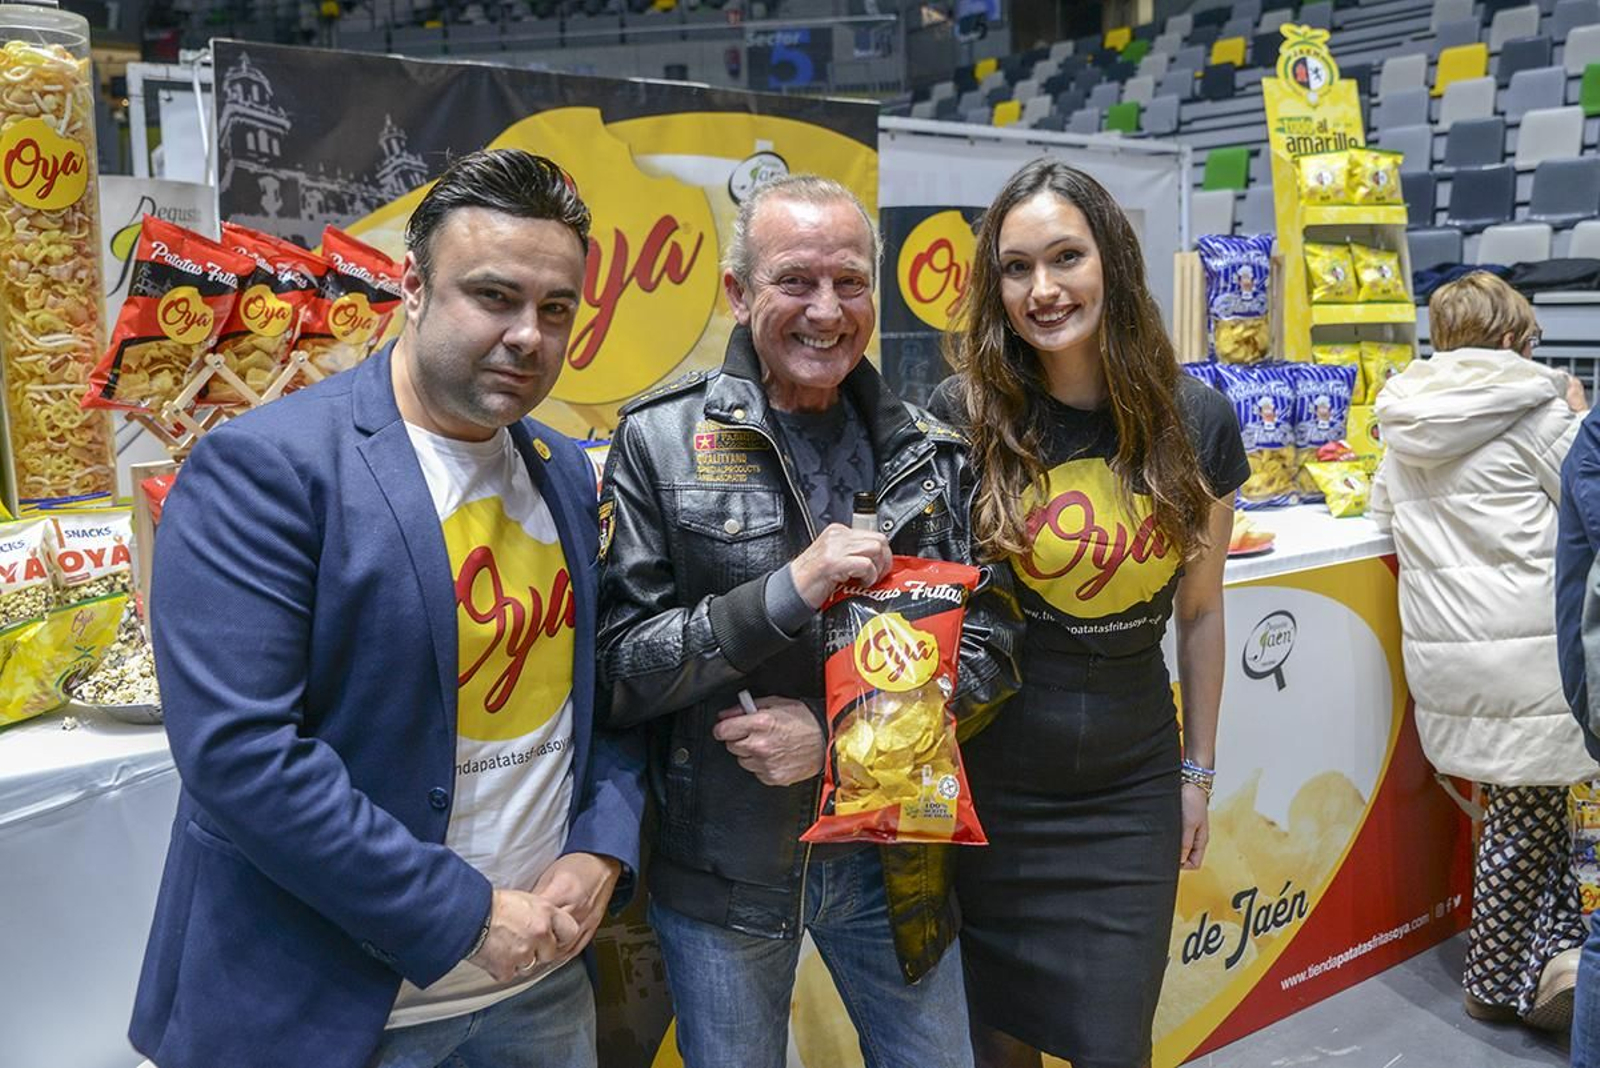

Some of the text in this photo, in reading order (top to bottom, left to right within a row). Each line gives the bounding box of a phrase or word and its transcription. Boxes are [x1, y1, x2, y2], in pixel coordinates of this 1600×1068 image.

[768, 28, 815, 91] 5
[1286, 132, 1358, 153] amarillo
[4, 138, 84, 199] Oya
[151, 241, 239, 289] Patatas Frita
[330, 252, 376, 284] Patatas
[909, 238, 970, 318] Oy
[244, 294, 290, 329] Oya
[567, 214, 704, 371] ya
[161, 297, 211, 336] Oya
[331, 303, 374, 336] Oya
[0, 540, 25, 553] CKS
[64, 526, 112, 539] SNACKS
[1020, 490, 1172, 601] Oya
[0, 556, 47, 584] YA
[904, 581, 962, 604] Fritas
[860, 628, 935, 683] Oya
[1182, 881, 1309, 970] de Jaén
[1281, 913, 1430, 990] www.tiendapatatasfritasoya.com
